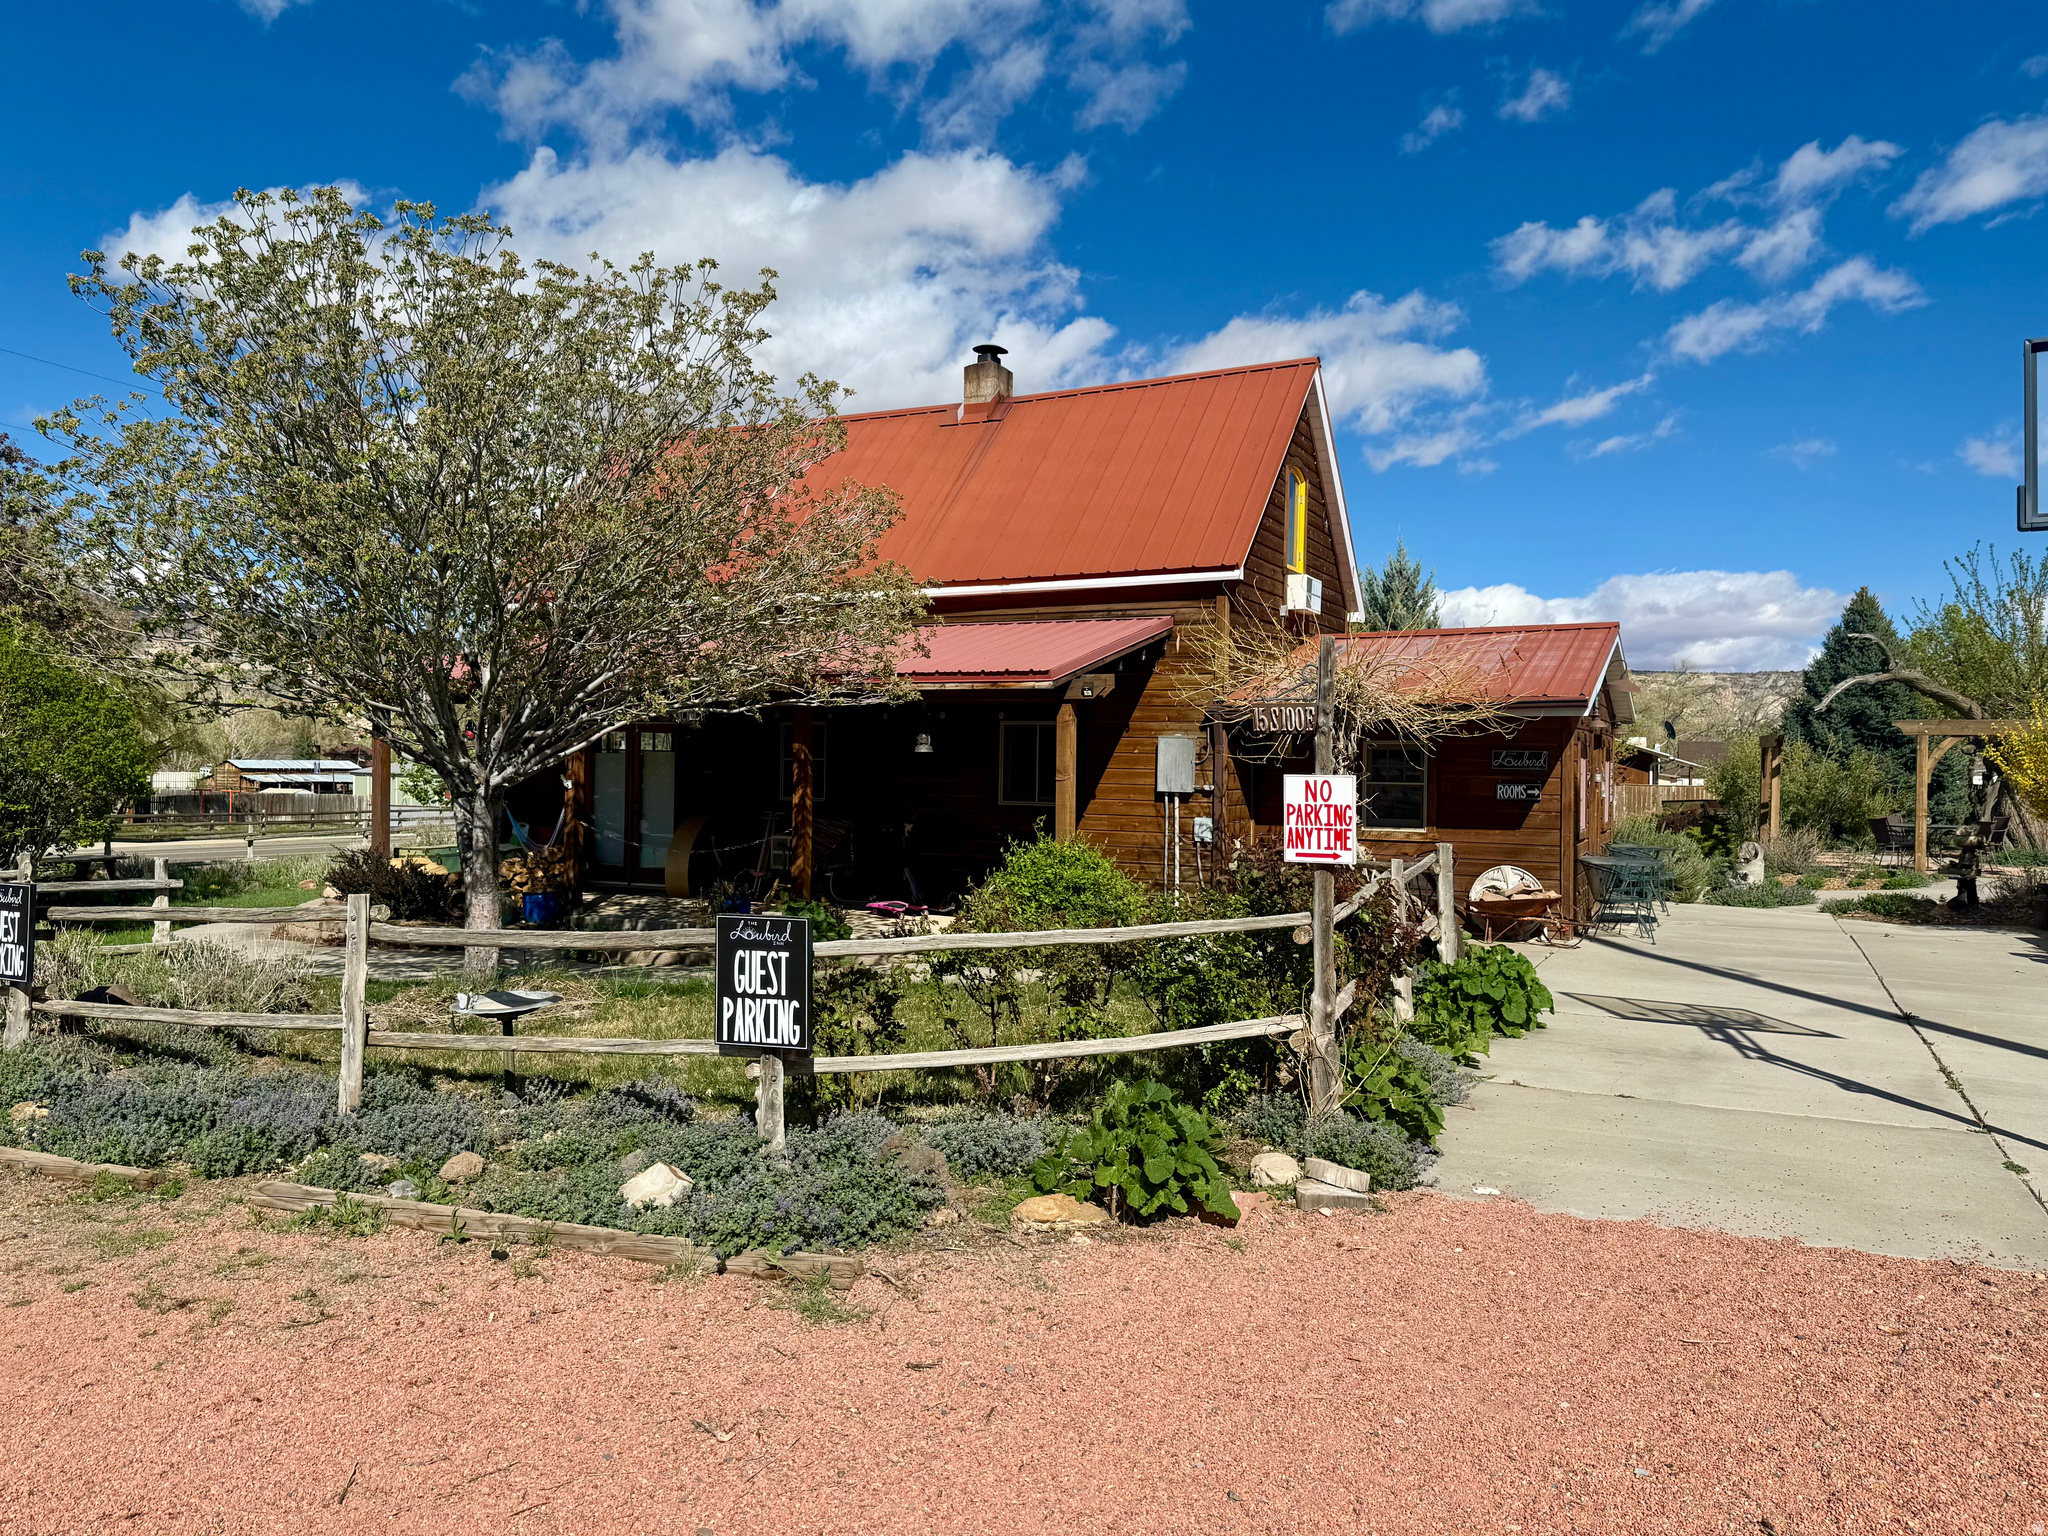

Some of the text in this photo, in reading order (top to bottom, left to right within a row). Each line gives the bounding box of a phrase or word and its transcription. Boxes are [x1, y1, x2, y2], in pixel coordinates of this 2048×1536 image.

[1253, 706, 1269, 732] 15
[1304, 779, 1332, 803] NO
[1497, 784, 1527, 799] ROOMS
[1286, 803, 1353, 827] PARKING
[1286, 826, 1353, 851] ANYTIME
[0, 910, 21, 943] EST
[0, 943, 25, 977] KING
[733, 949, 790, 996] GUEST
[722, 996, 801, 1046] PARKING
